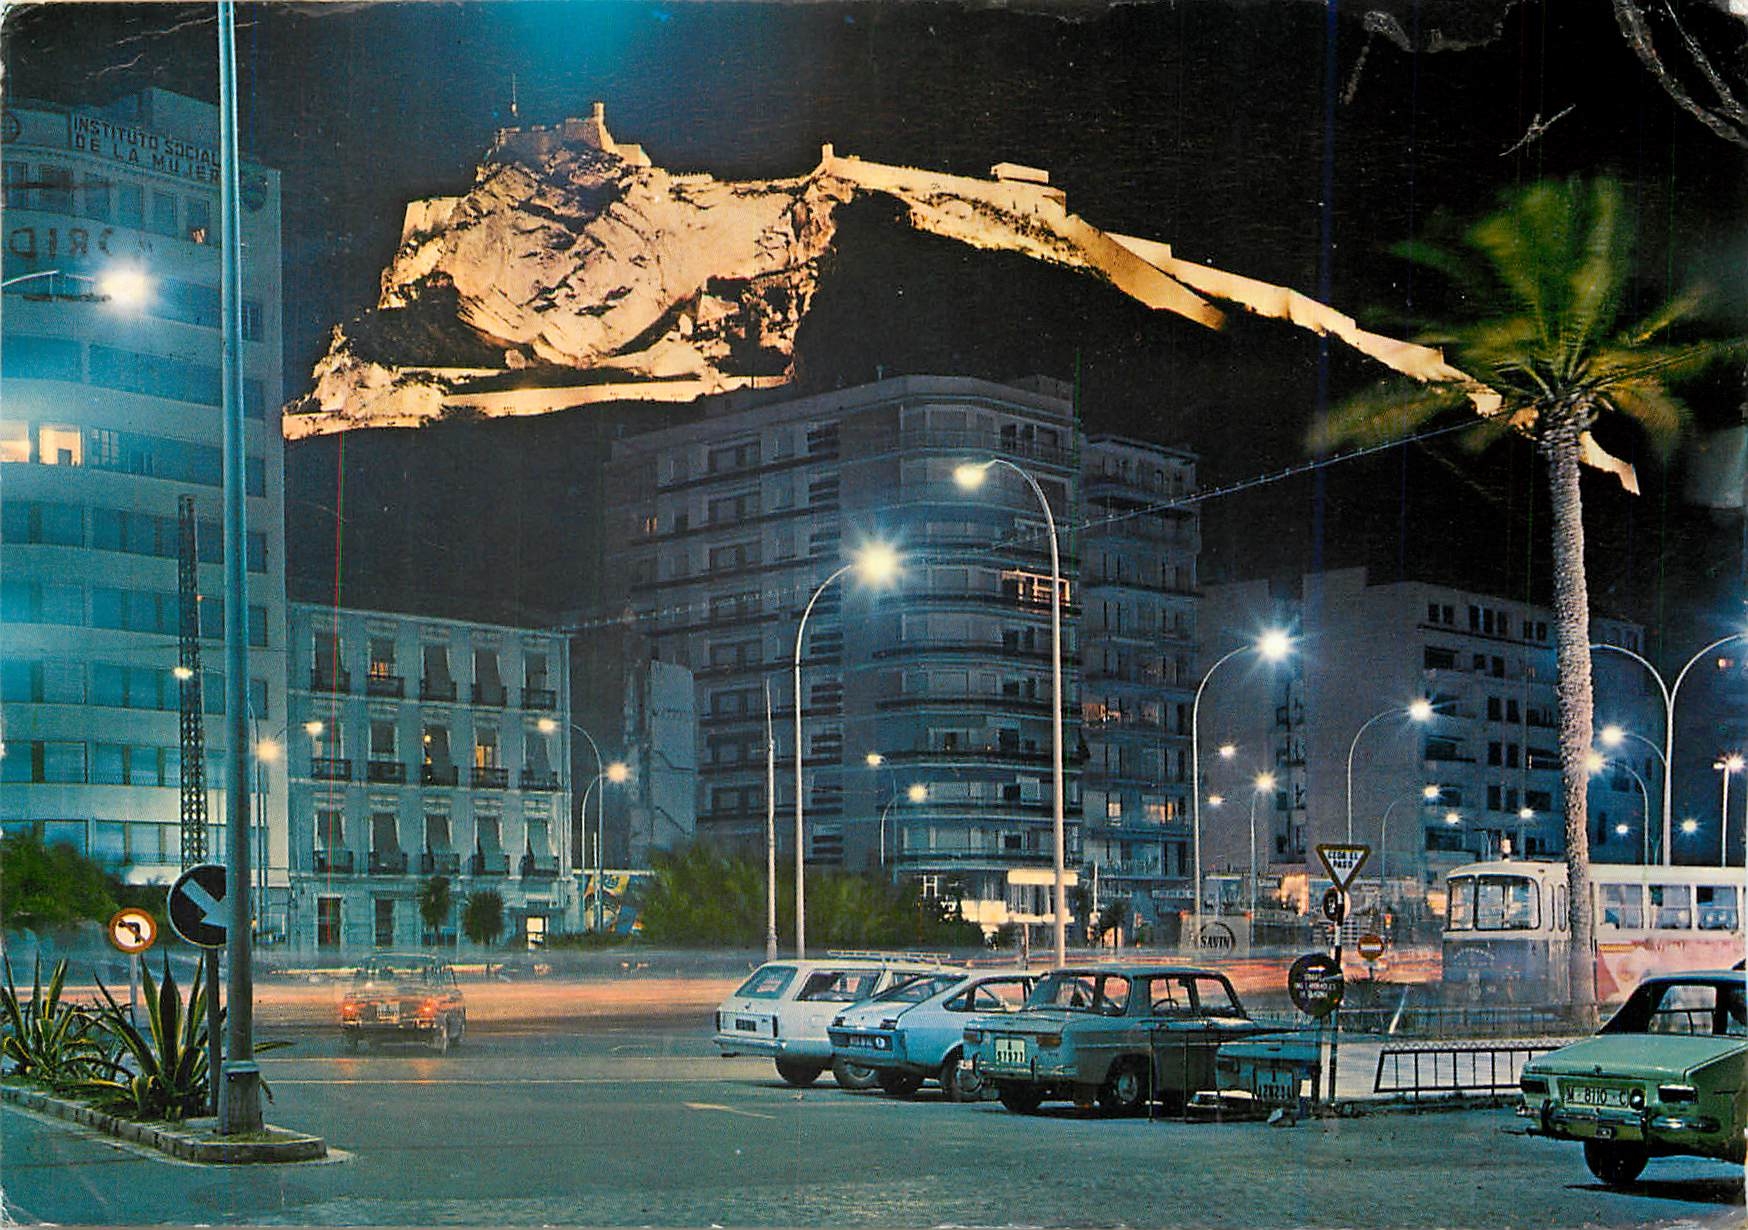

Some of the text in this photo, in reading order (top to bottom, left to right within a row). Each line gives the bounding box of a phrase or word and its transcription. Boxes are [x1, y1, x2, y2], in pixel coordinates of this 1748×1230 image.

[74, 112, 221, 169] INSTITUTO SOCIAL
[75, 134, 100, 152] DE
[113, 144, 139, 163] LA
[1333, 860, 1353, 869] PASO
